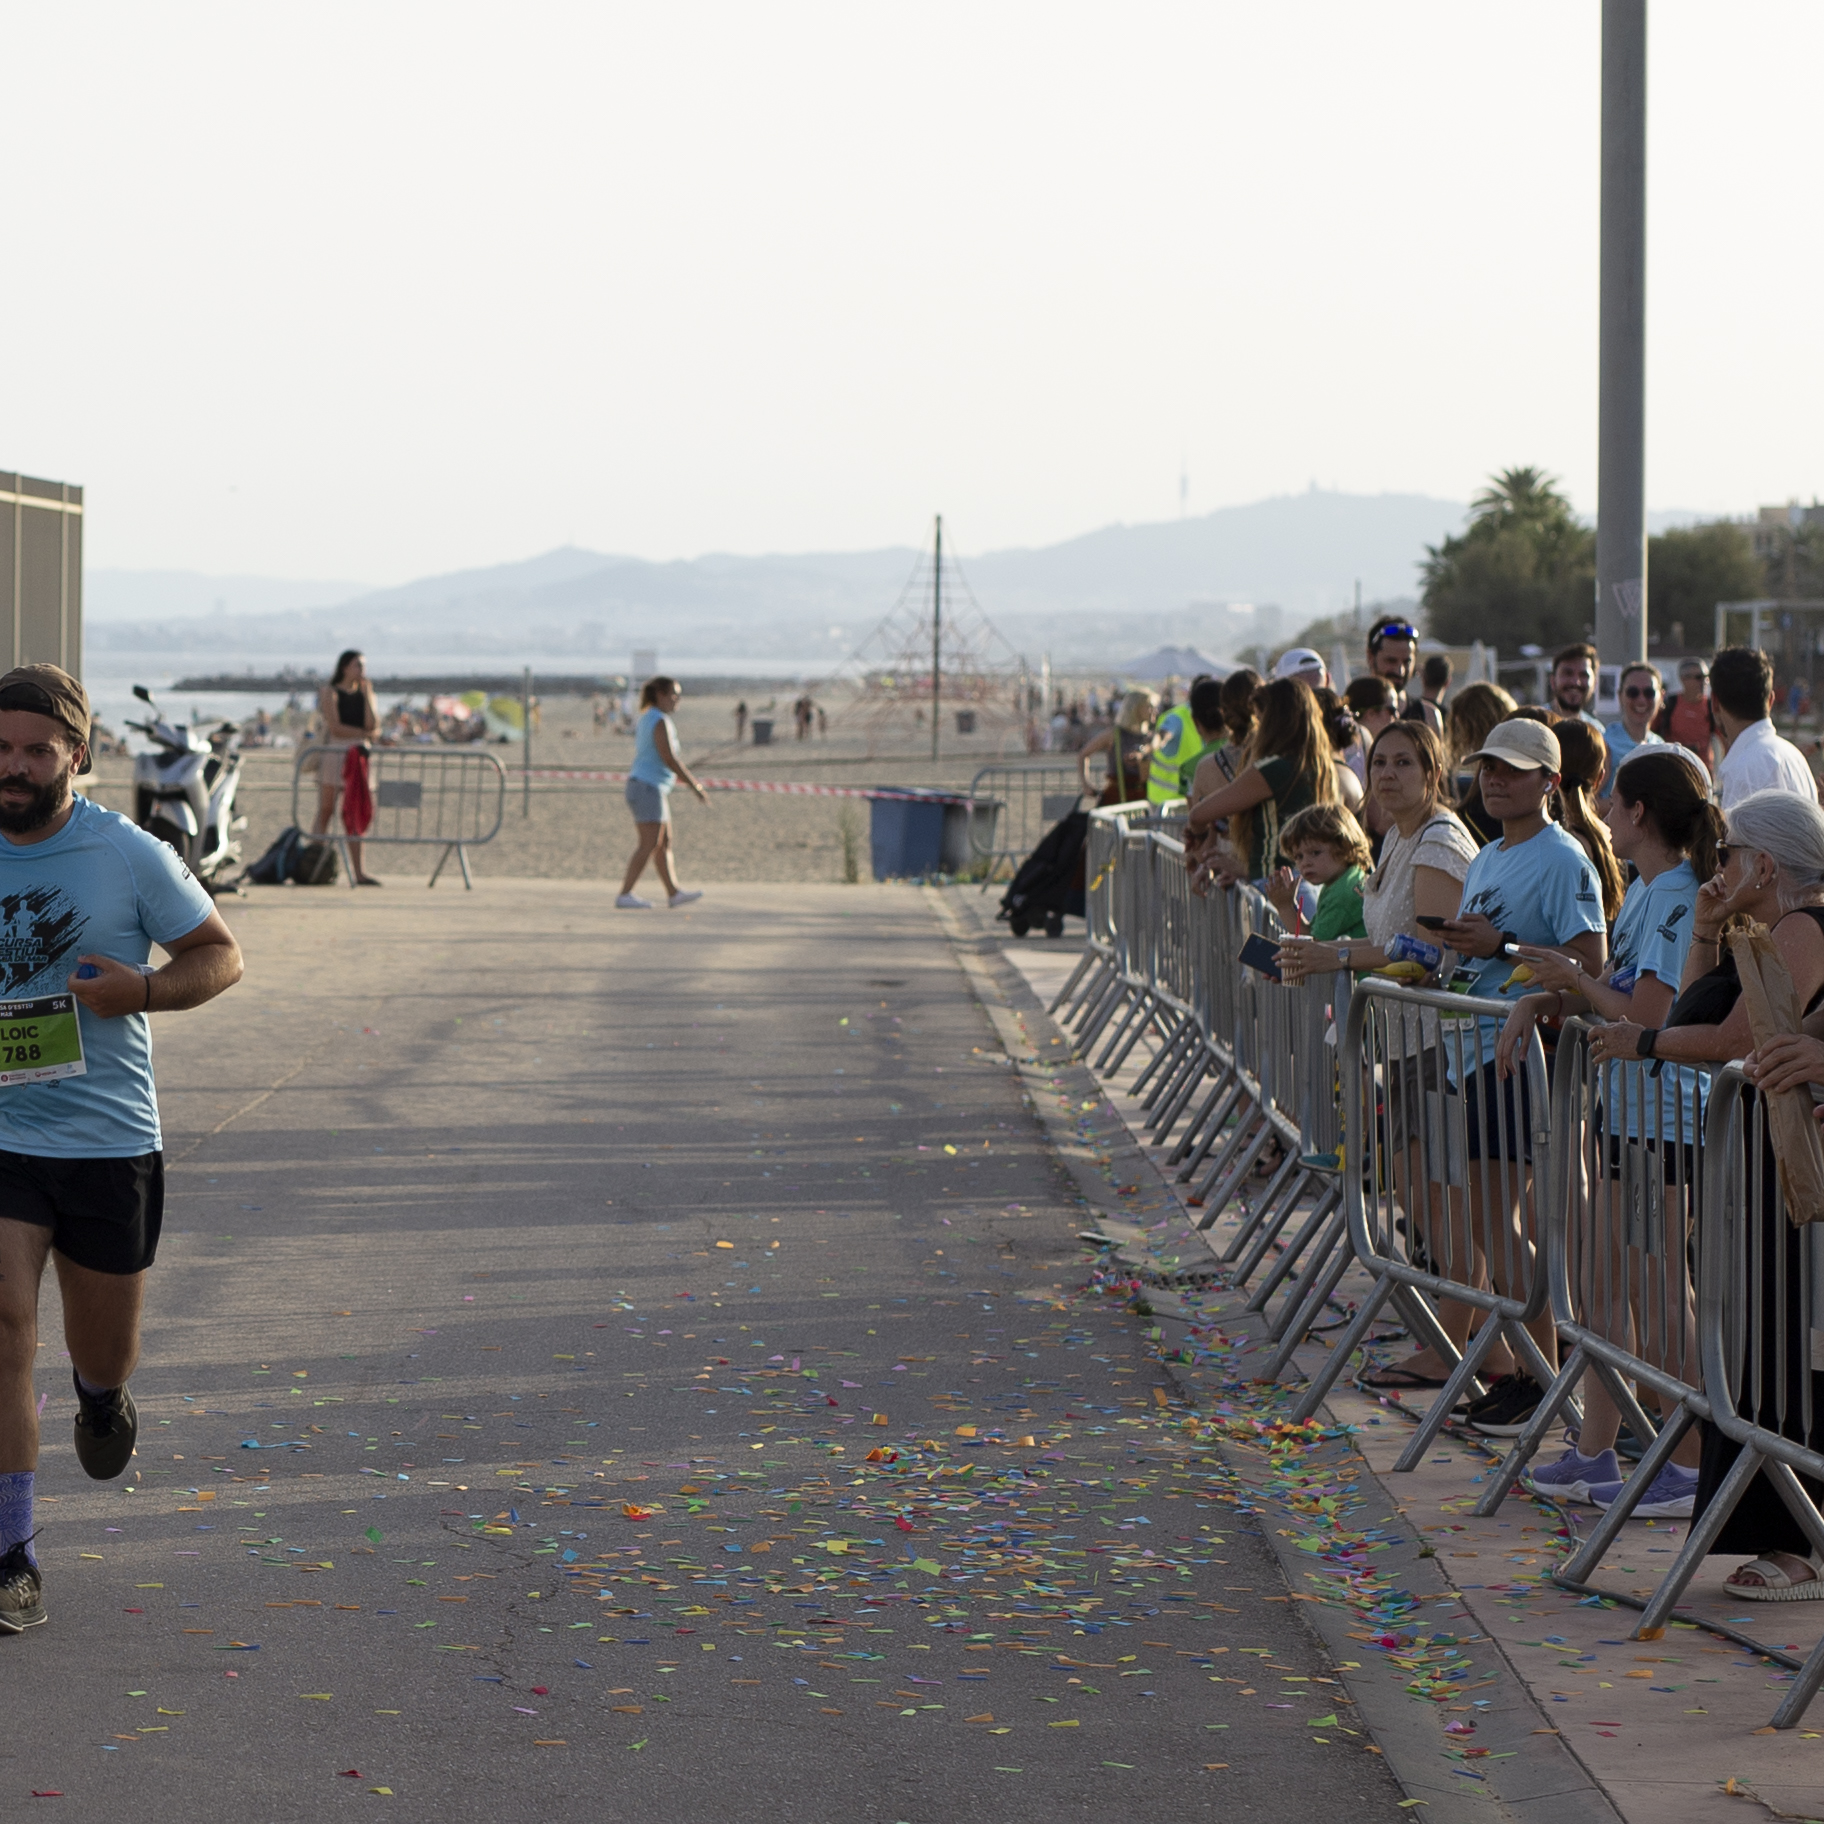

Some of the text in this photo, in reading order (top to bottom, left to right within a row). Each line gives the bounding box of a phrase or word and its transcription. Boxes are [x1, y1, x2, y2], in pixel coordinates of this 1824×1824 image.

[52, 999, 67, 1010] 5K
[0, 1025, 40, 1041] LOIC
[2, 1044, 42, 1063] 788
